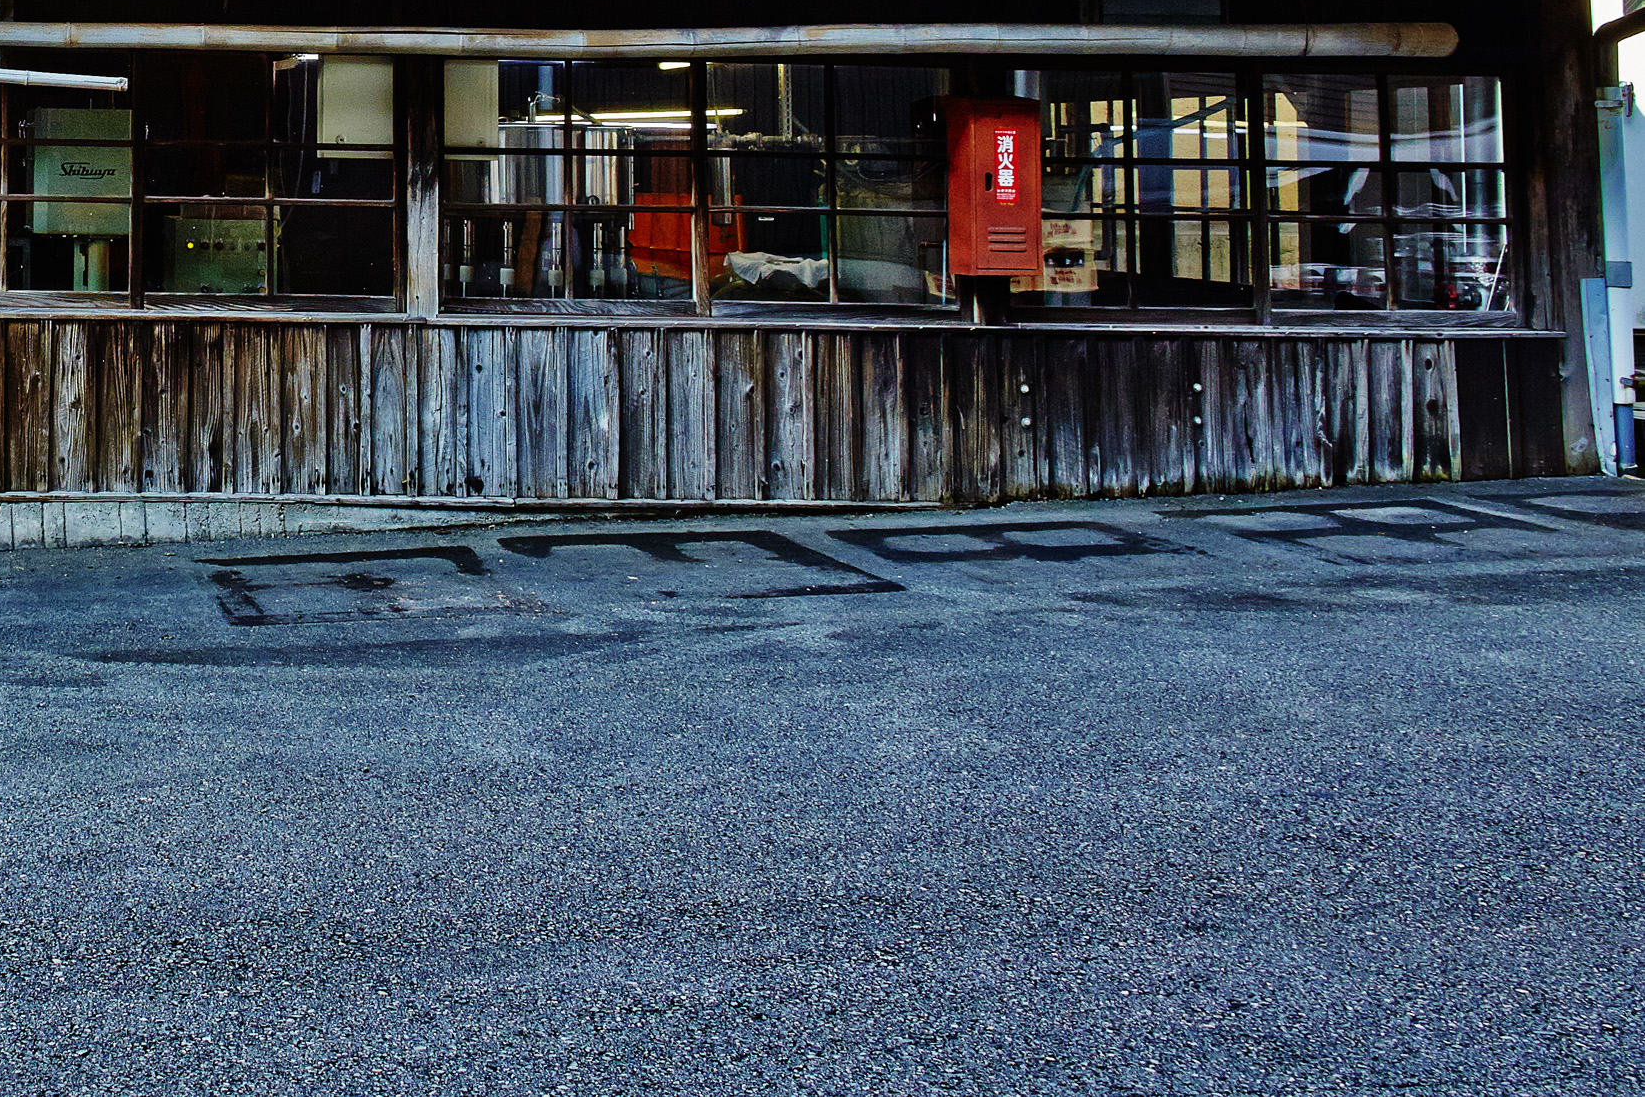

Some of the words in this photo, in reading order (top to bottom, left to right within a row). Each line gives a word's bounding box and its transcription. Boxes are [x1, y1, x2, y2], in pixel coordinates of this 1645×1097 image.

[59, 162, 116, 180] Shibuya
[997, 135, 1014, 187] 消火器
